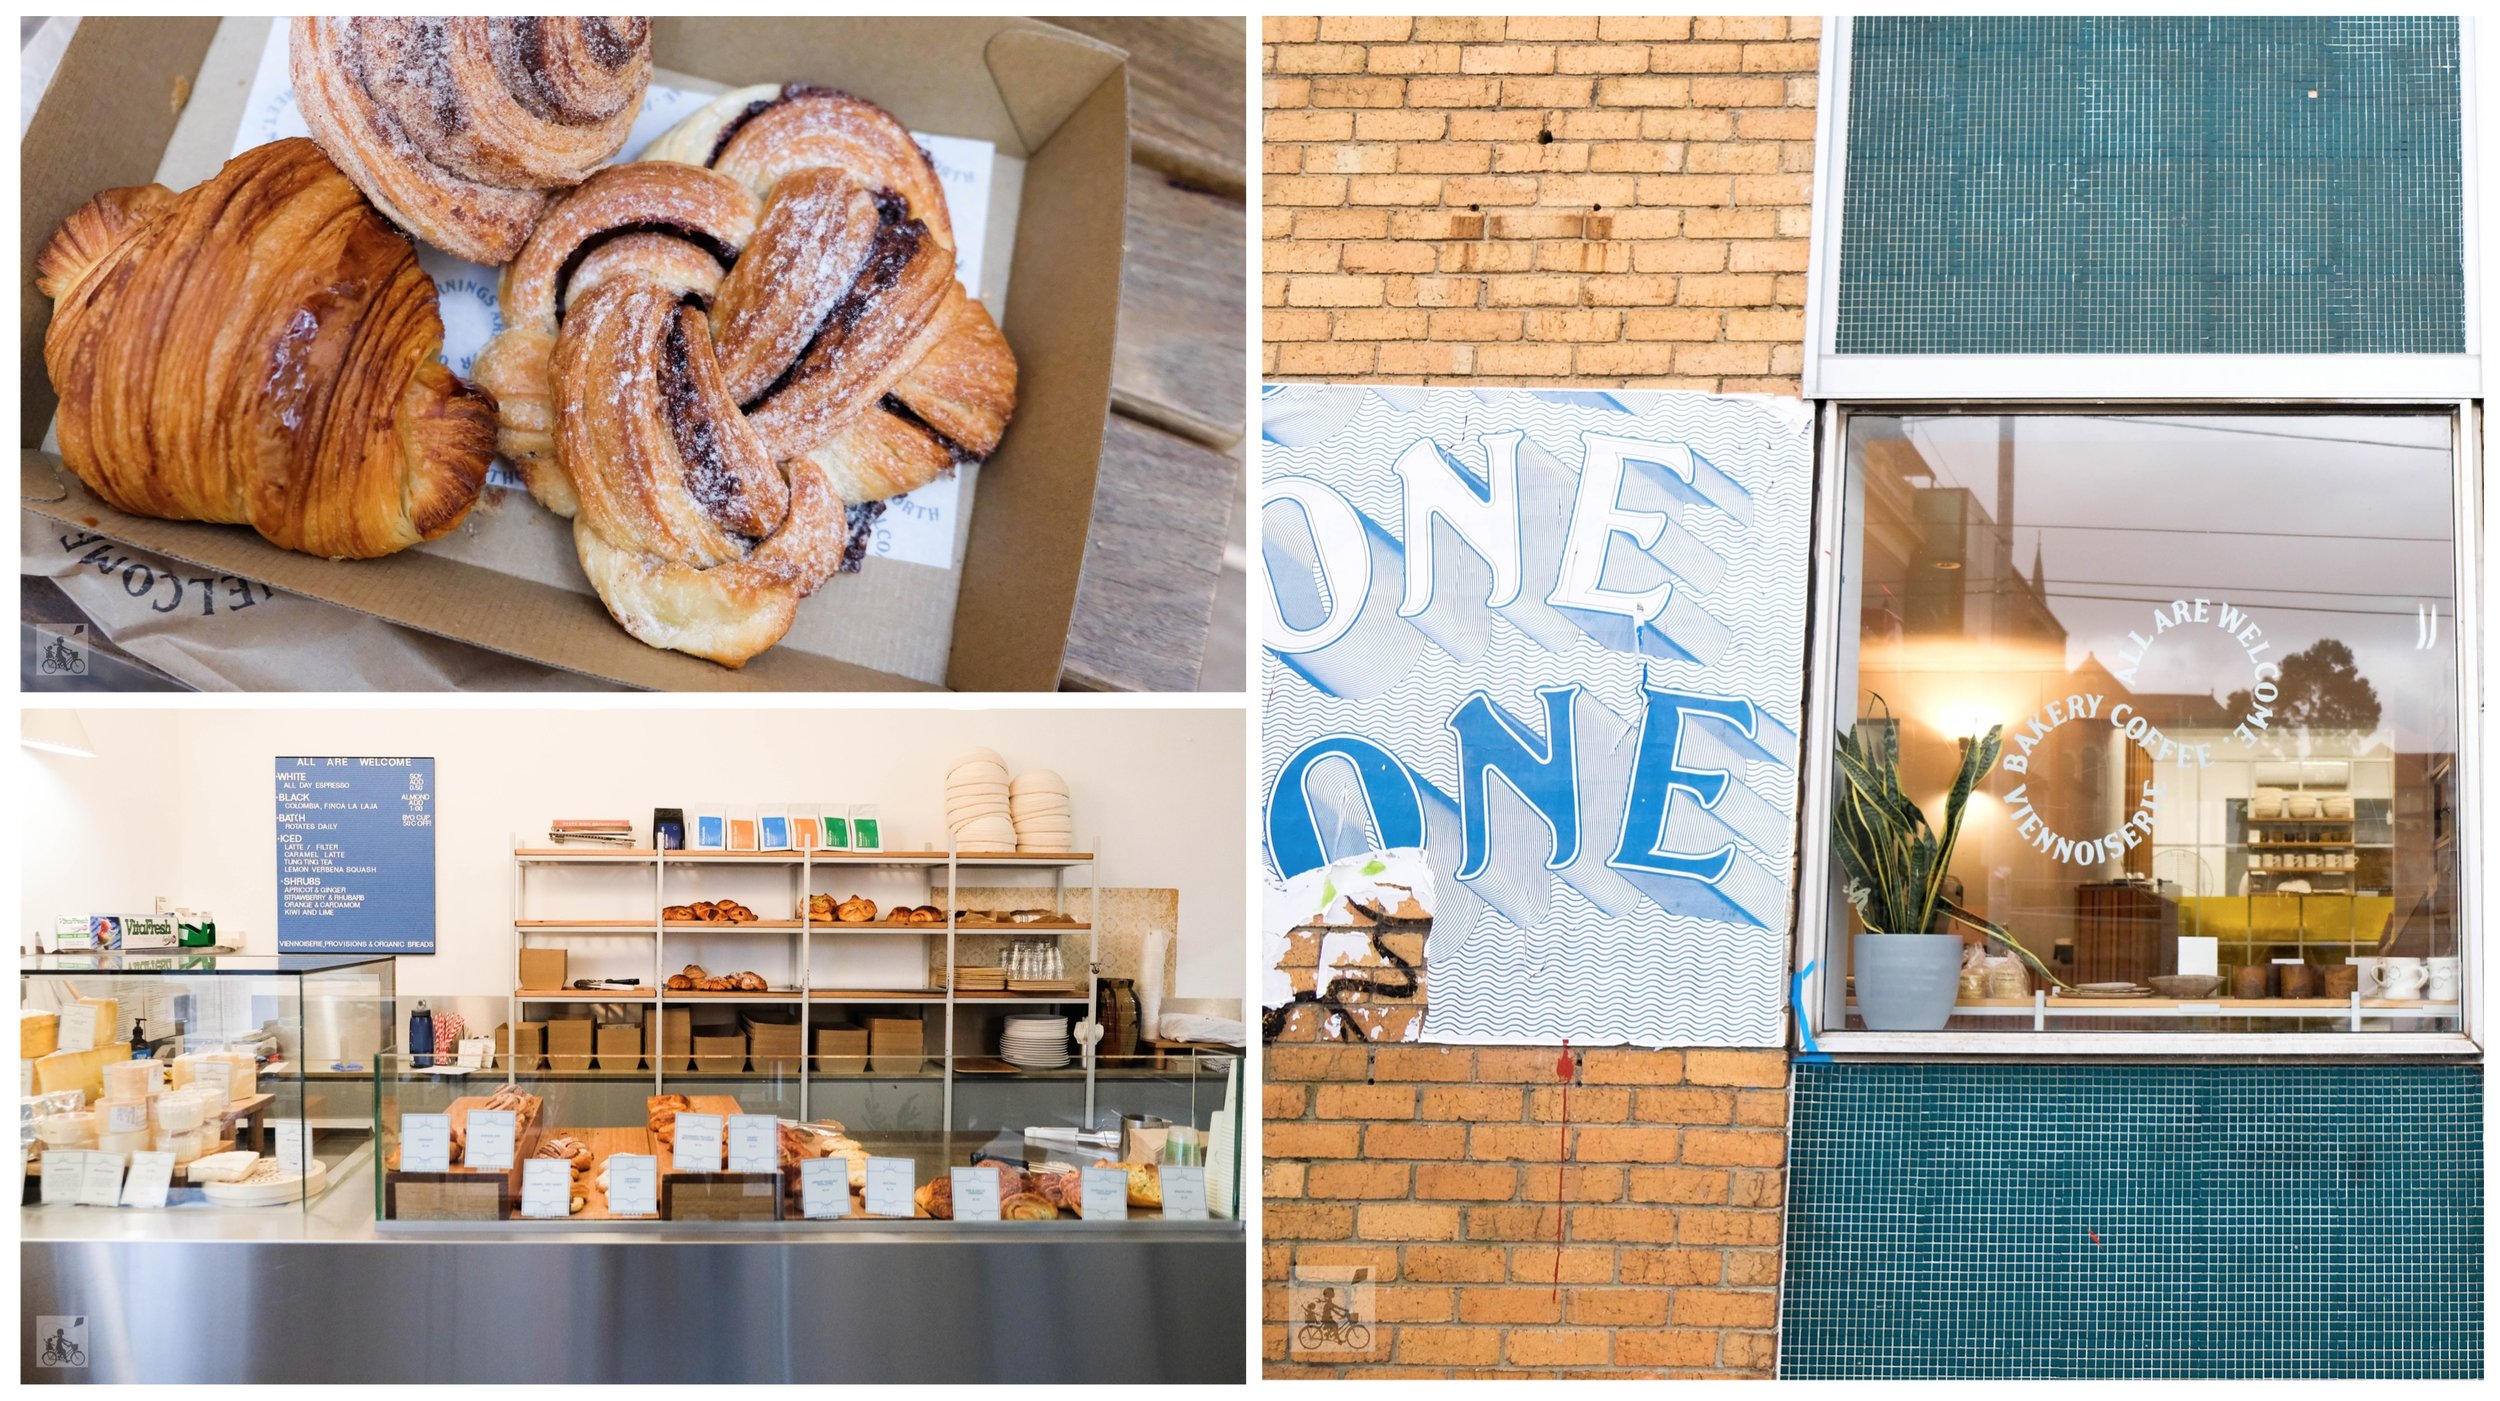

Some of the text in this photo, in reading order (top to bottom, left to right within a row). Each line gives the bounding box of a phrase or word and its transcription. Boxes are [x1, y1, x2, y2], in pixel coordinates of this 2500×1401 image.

[1262, 428, 1697, 654] ONE
[2114, 598, 2279, 749] ALL ARE WELCOME
[278, 772, 306, 781] WHITE
[297, 758, 411, 766] ALL ARE WELCOME
[1264, 681, 1760, 886] ONE
[2003, 694, 2215, 866] VIENNOISERIE BAKERY COFFEE
[280, 835, 302, 843] ICED
[125, 919, 171, 935] VitaFresh
